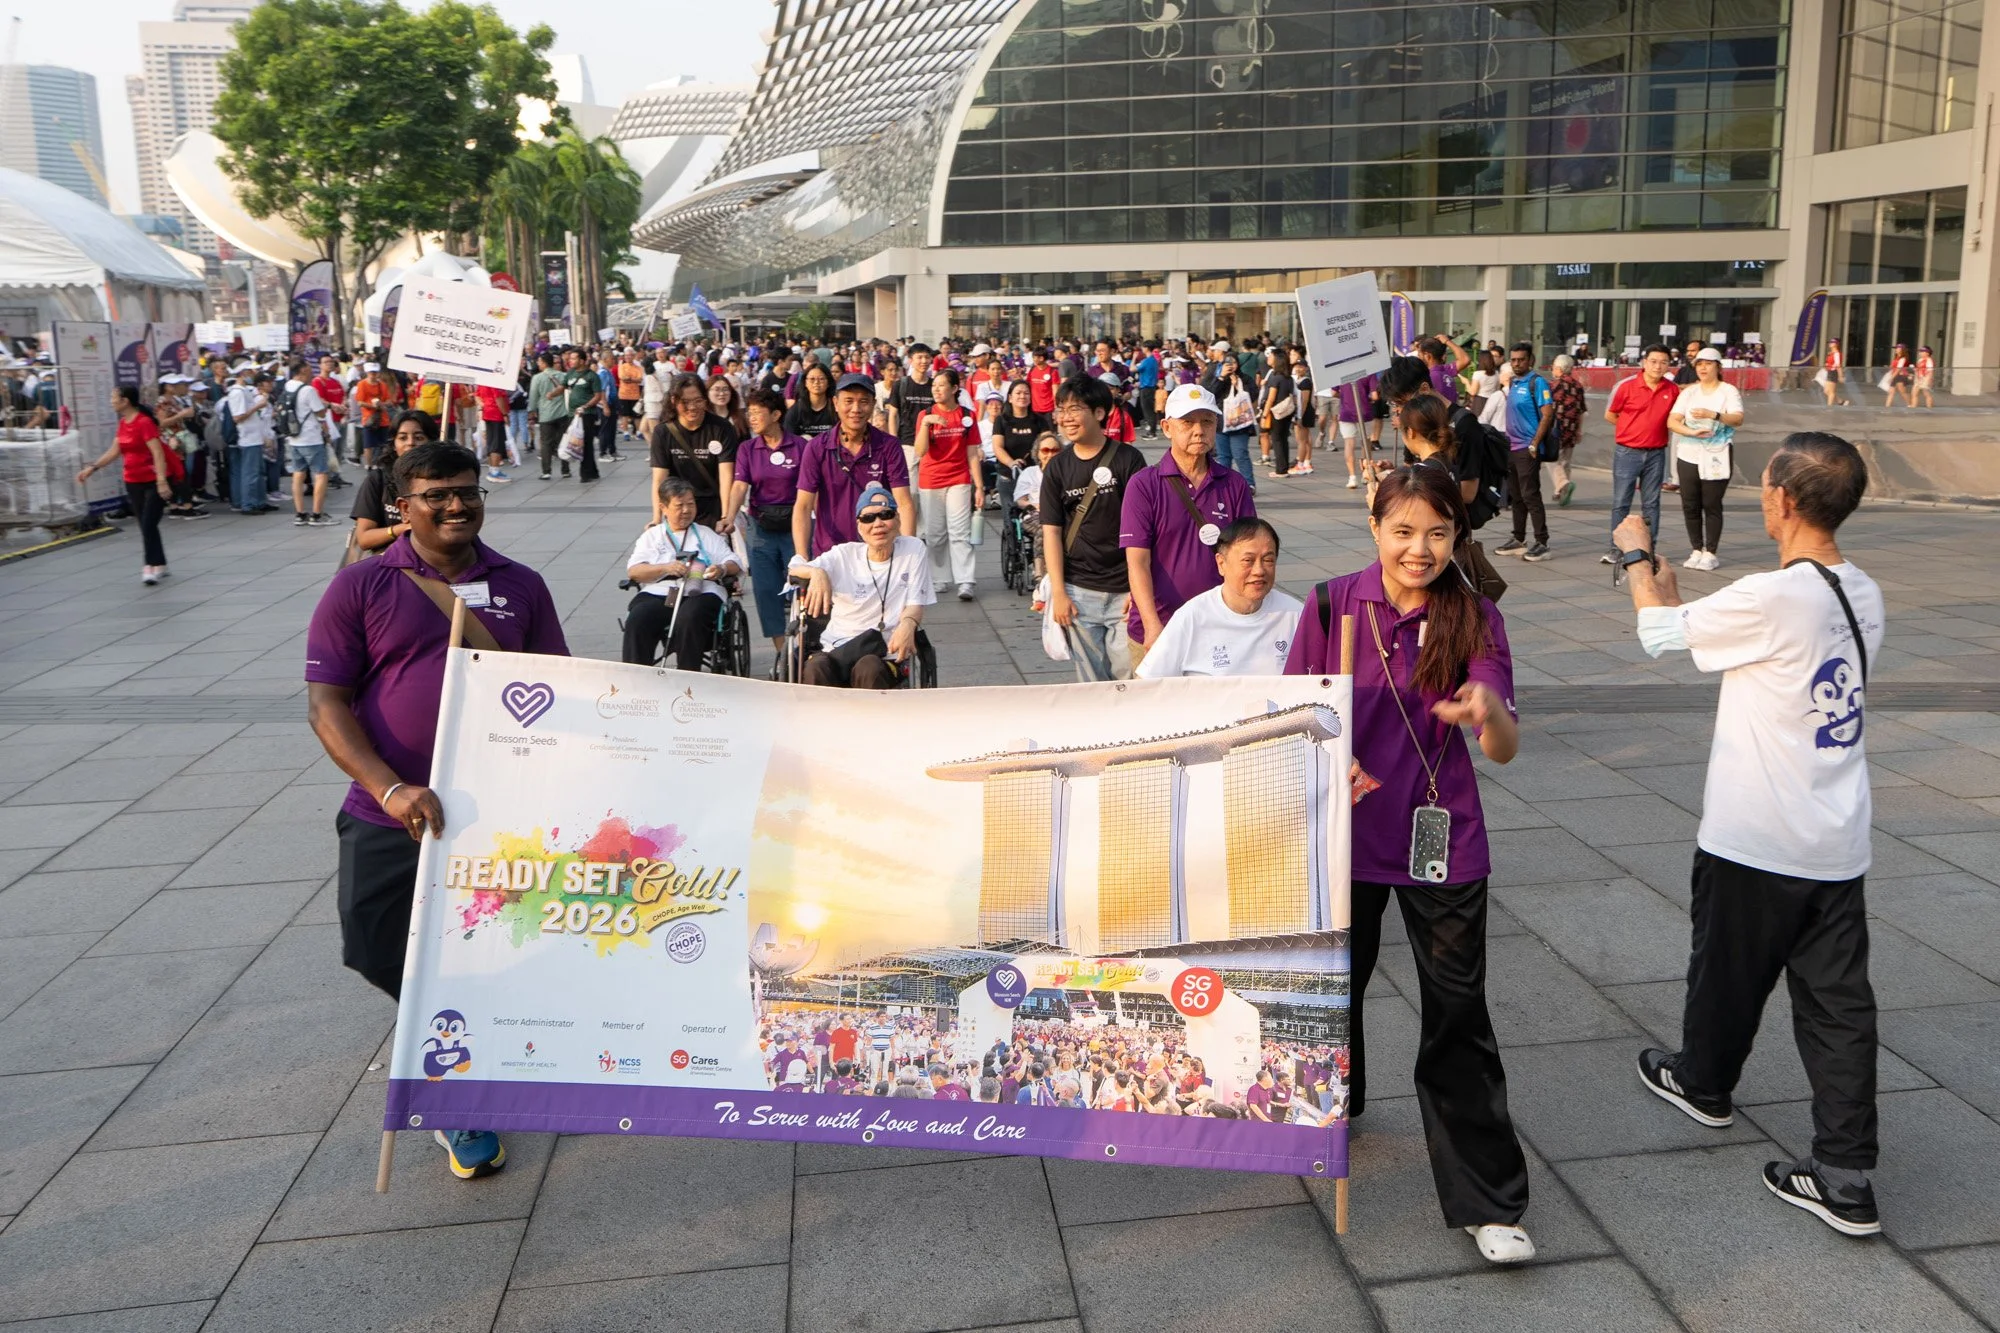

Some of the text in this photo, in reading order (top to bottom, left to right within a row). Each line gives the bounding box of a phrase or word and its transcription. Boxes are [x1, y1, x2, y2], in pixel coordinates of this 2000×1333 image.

[1557, 263, 1591, 275] TASAKI
[424, 313, 496, 334] BEFRIENDING
[1326, 310, 1359, 325] BEFRIENDING
[1325, 319, 1367, 336] MEDICAL ESCORT
[414, 325, 507, 348] MEDICAL ESCORT
[1338, 332, 1359, 343] SERVICE
[435, 341, 481, 357] SERVICE
[601, 703, 660, 711] TRANSPARENCY
[679, 706, 728, 715] TRANSPARENCY
[488, 732, 558, 746] Blossom Seeds
[446, 855, 741, 903] READY SET Gold!
[541, 901, 638, 936] 2026
[652, 908, 676, 921] CHOPE,
[669, 934, 703, 952] CHOPE
[1035, 963, 1073, 976] READY
[1078, 963, 1099, 976] SET
[1183, 974, 1213, 992] SG
[1180, 993, 1210, 1009] 60
[493, 1017, 575, 1028] Sector Administrator
[602, 1021, 645, 1031] Member of
[681, 1024, 726, 1035] Operator of
[619, 1058, 641, 1067] NCSS
[672, 1054, 687, 1064] SG
[691, 1055, 719, 1066] Cares
[714, 1101, 1026, 1141] To Serve with Love and Care
